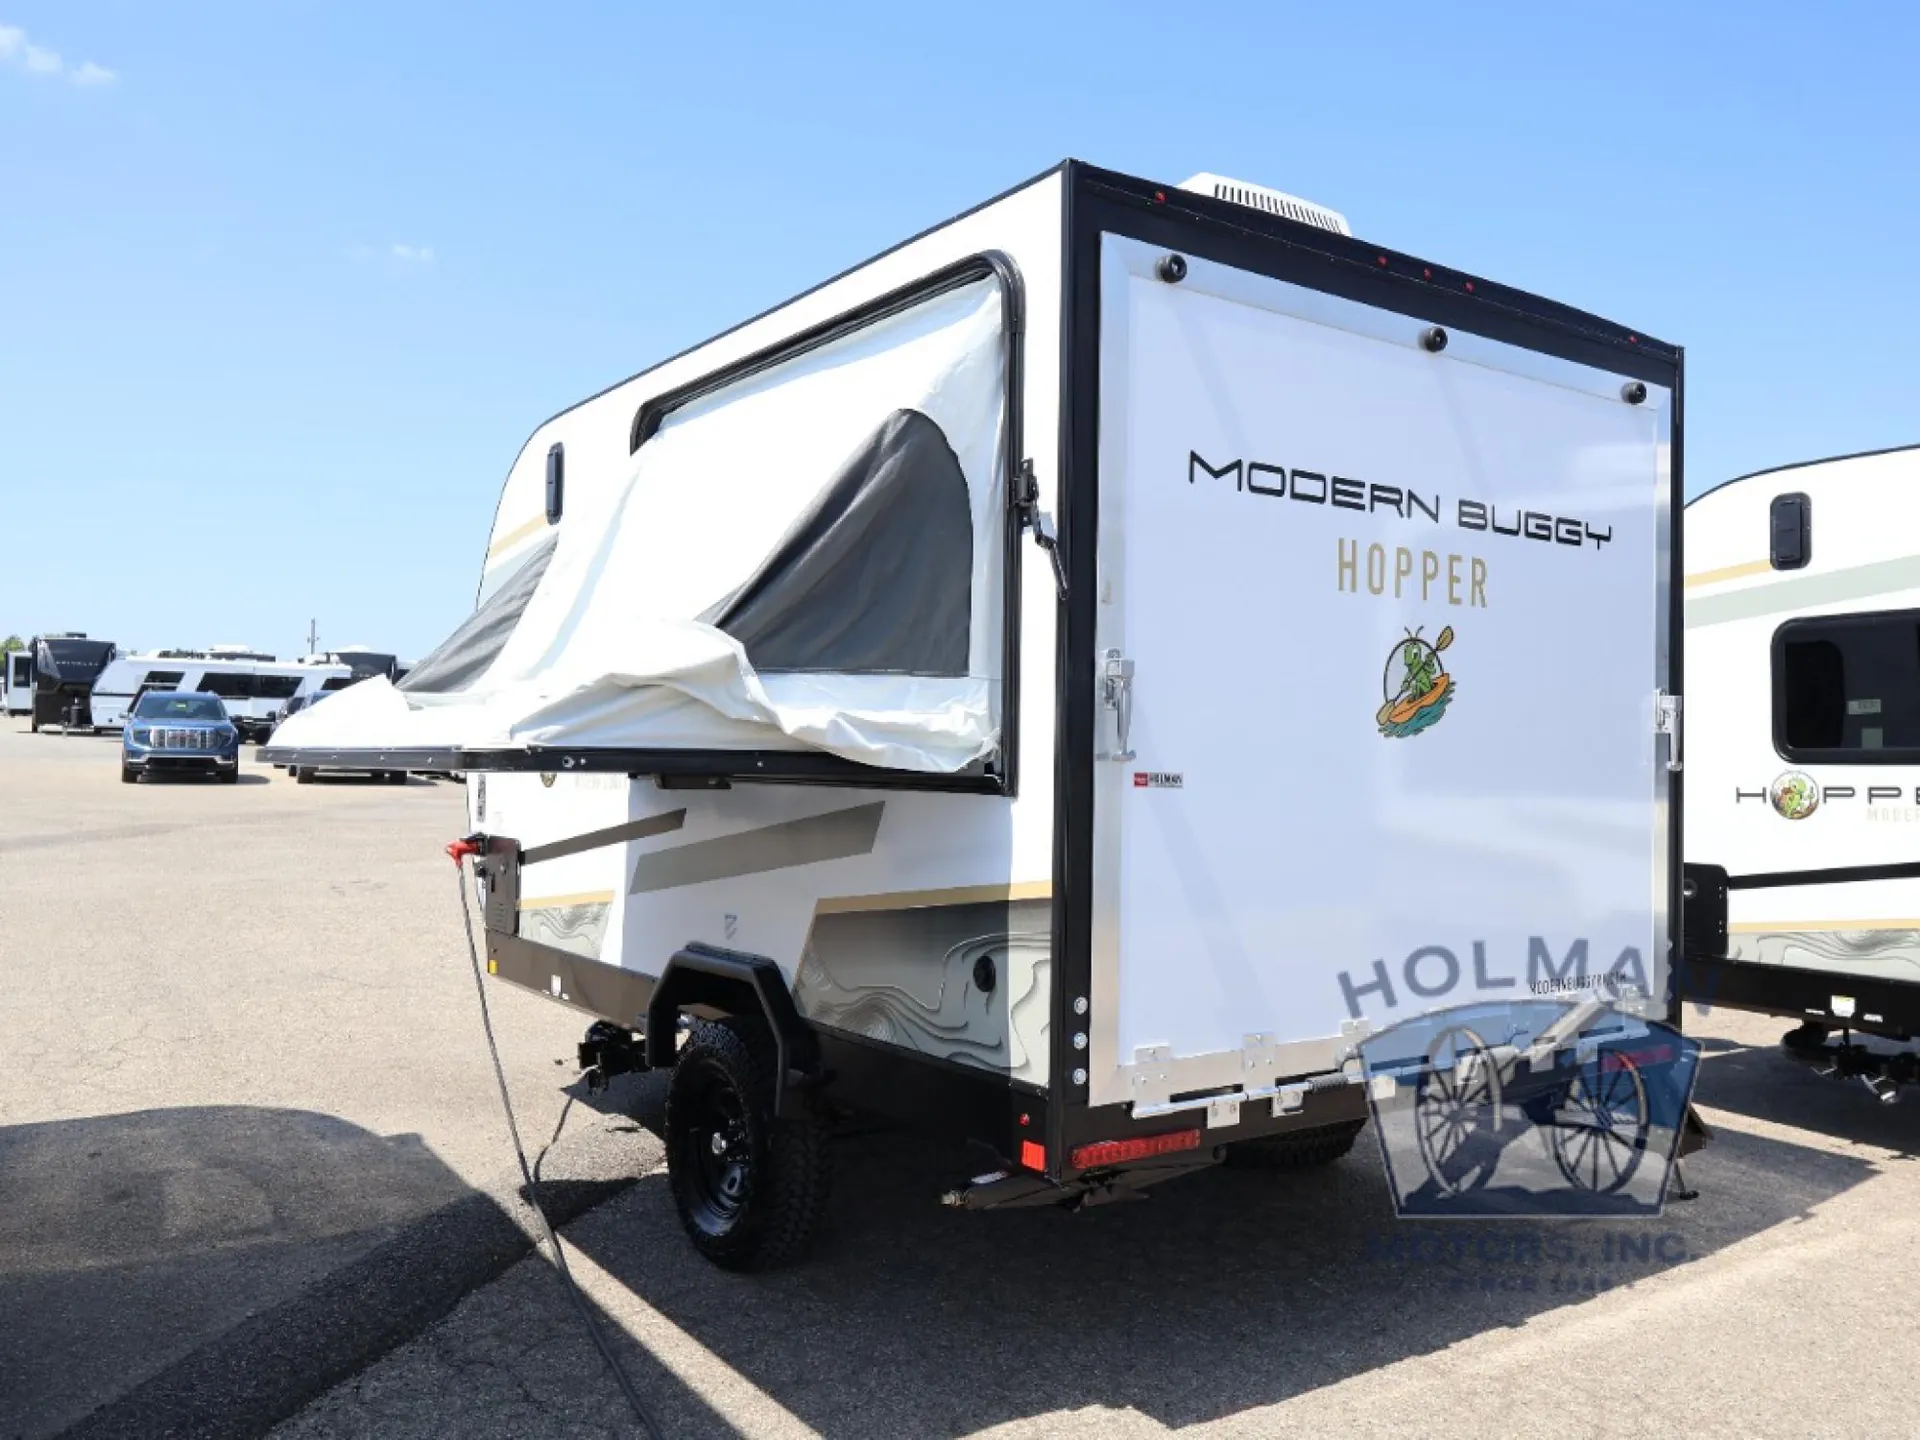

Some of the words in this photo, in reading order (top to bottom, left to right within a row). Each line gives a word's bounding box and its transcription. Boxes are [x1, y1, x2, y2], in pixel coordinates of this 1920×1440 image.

[1189, 450, 1440, 524] MODERN
[1458, 499, 1612, 550] BUGGY
[1338, 537, 1488, 608] HOPPER
